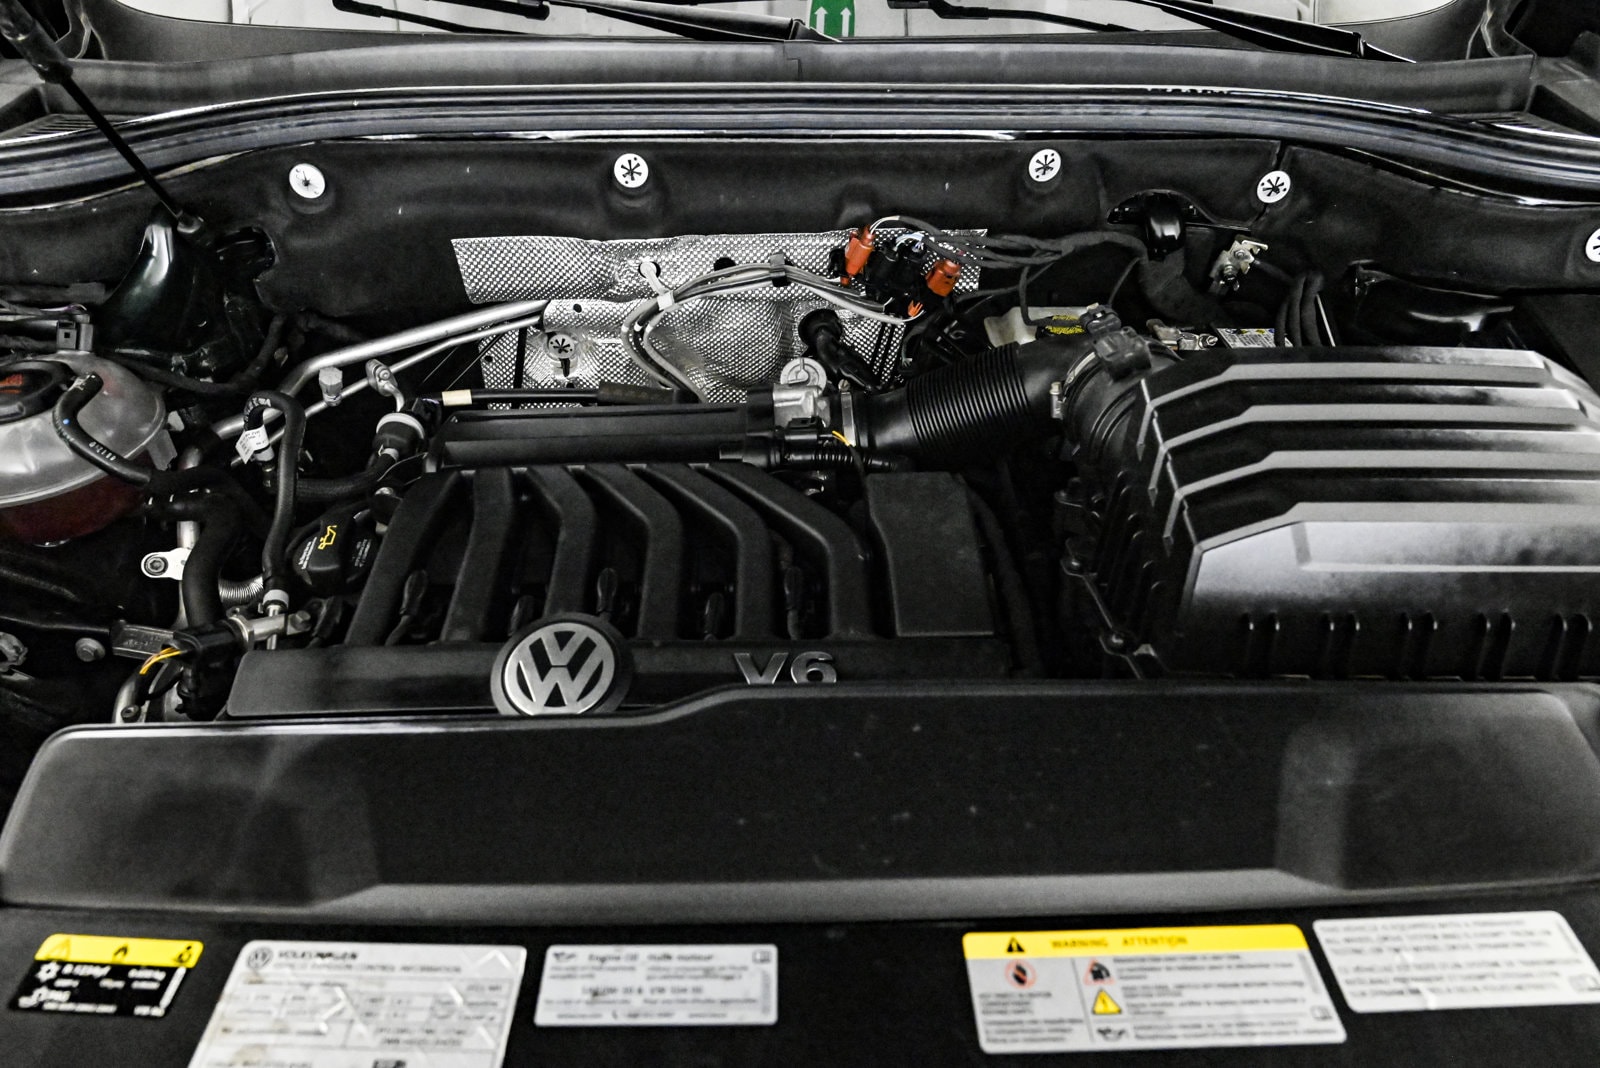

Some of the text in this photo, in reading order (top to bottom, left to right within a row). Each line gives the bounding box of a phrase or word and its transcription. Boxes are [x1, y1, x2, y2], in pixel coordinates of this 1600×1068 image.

[734, 651, 837, 684] V6
[1051, 935, 1188, 949] WARNING ATTENTION
